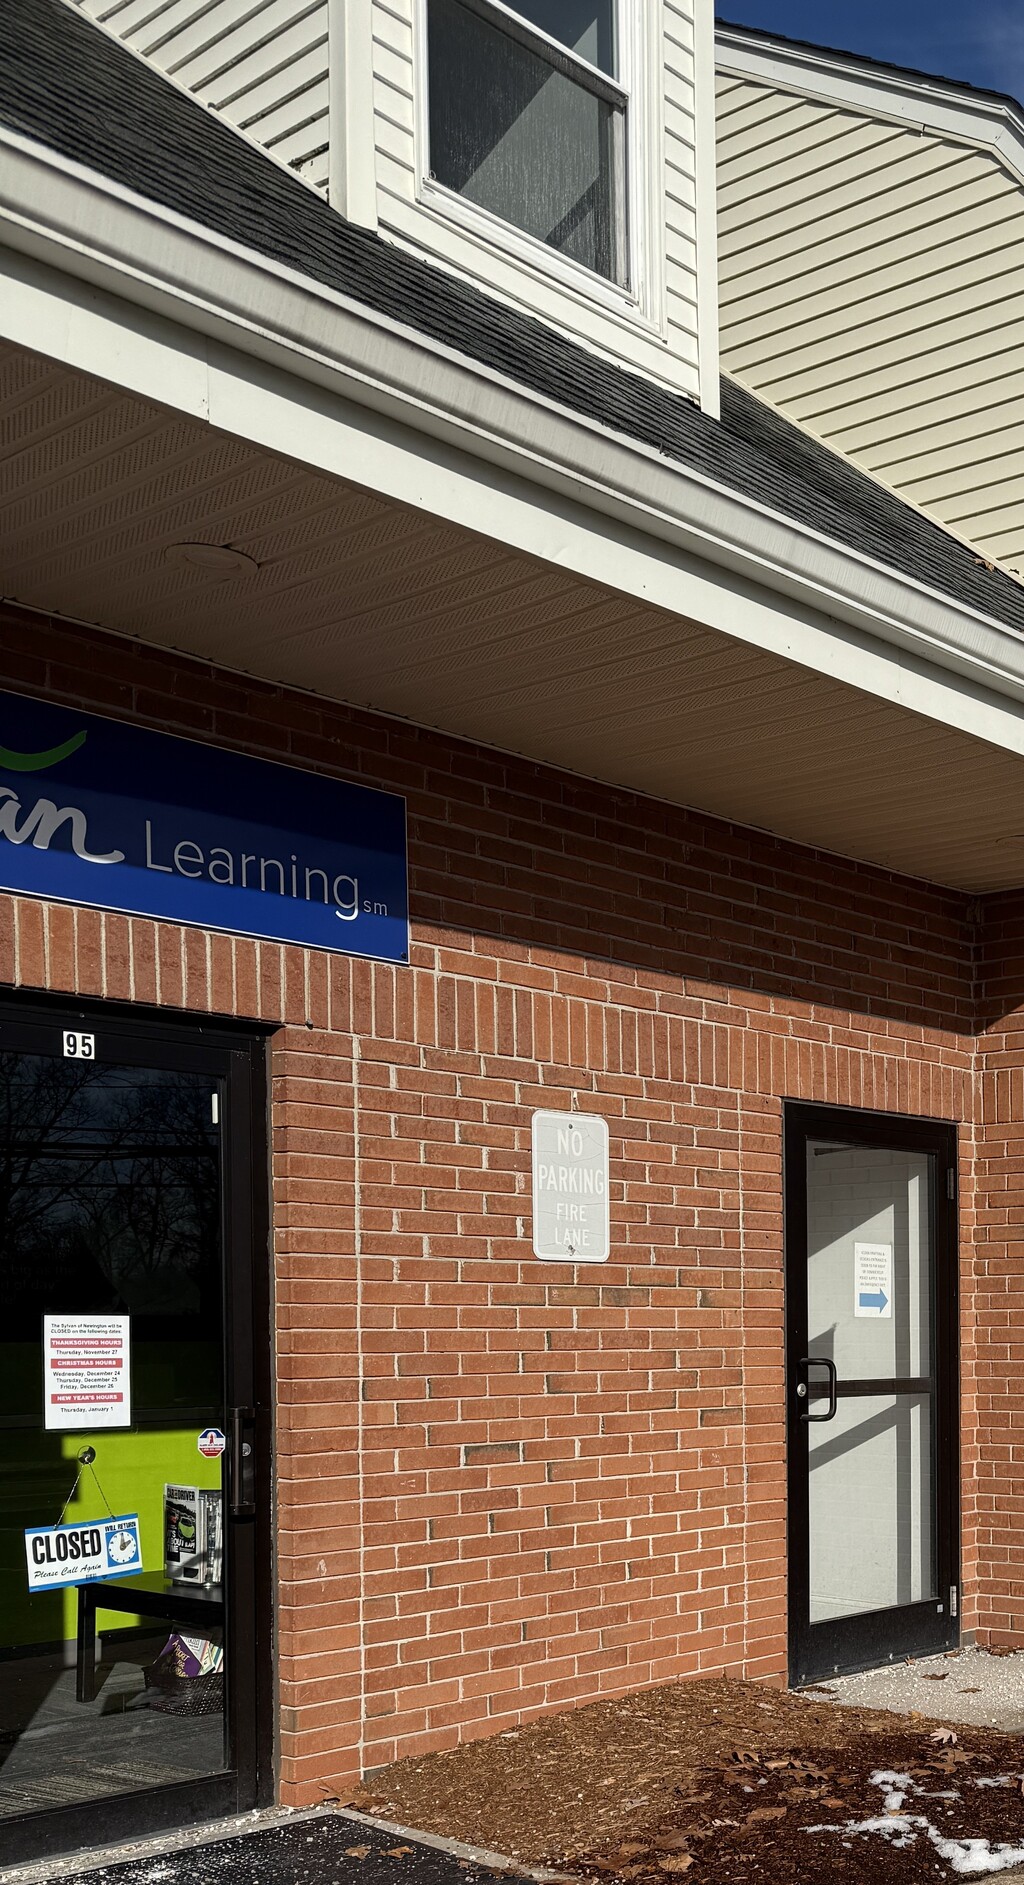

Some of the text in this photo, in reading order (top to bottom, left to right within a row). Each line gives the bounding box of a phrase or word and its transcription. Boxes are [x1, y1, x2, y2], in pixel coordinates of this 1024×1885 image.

[146, 820, 358, 921] Learning
[363, 900, 388, 916] sm
[66, 1033, 92, 1057] 95
[557, 1129, 583, 1157] NO
[538, 1164, 604, 1195] PARKING
[556, 1203, 587, 1222] FIRE
[554, 1227, 590, 1246] LANE
[178, 1489, 196, 1502] DRIVER
[117, 1521, 137, 1530] RETURN
[32, 1528, 102, 1565] CLOSED
[34, 1564, 102, 1579] Please Call Again
